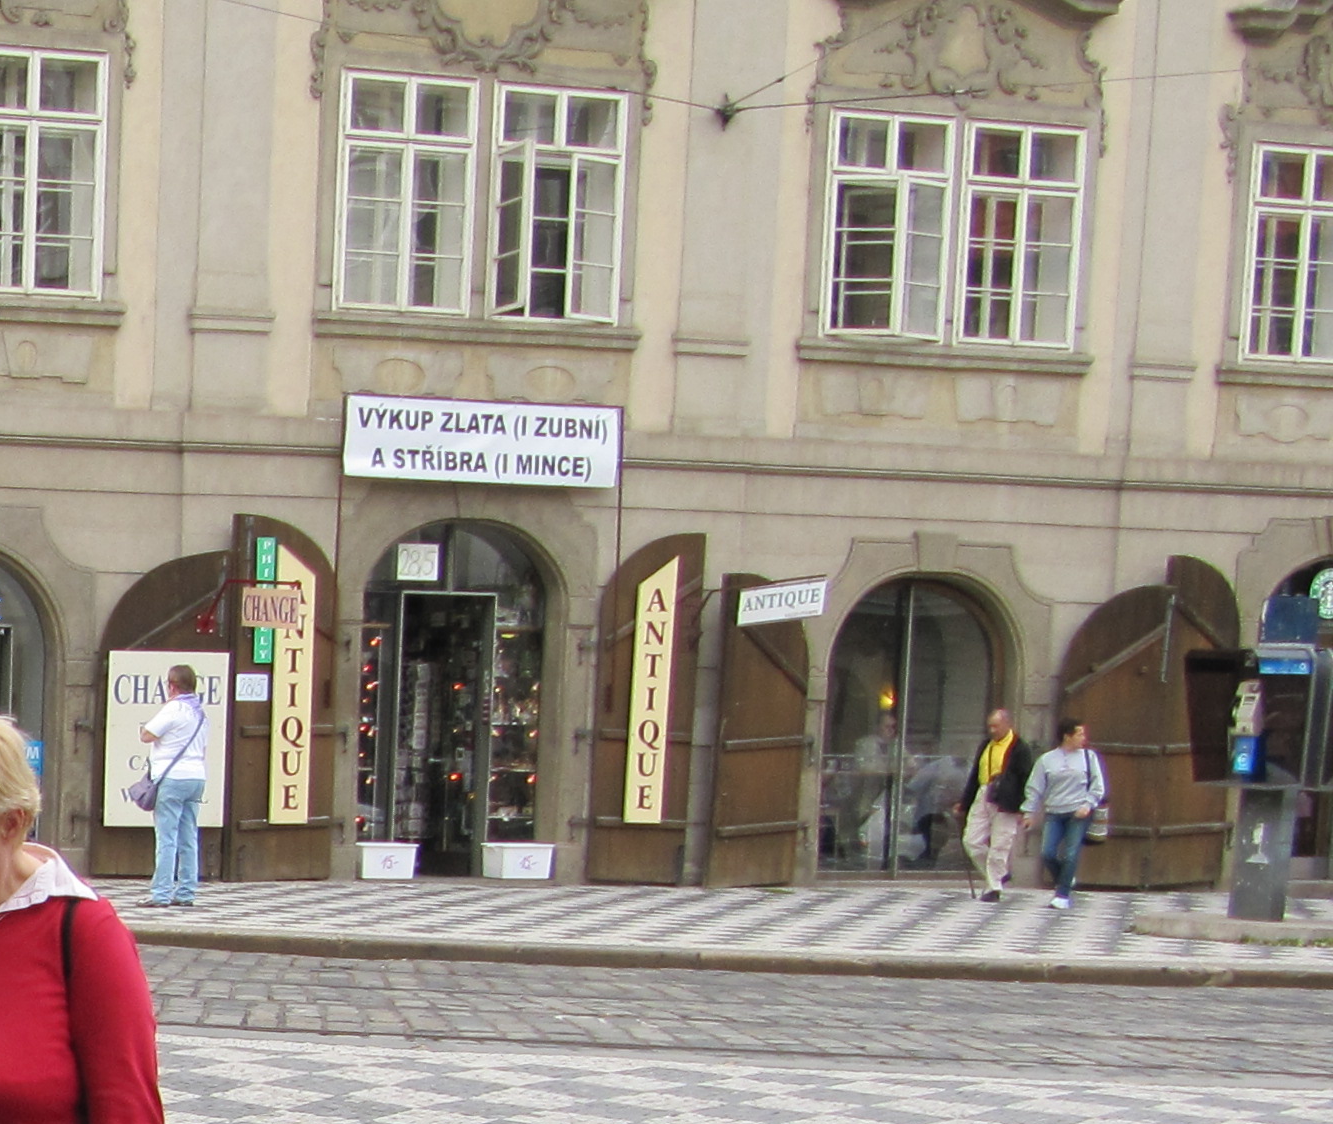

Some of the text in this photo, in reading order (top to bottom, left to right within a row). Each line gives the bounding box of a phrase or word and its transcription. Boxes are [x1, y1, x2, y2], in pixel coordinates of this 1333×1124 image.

[358, 402, 608, 445] VÝKUP ZLATA (I ZUBNÍ)
[371, 445, 592, 483] A STŘÍBRA (I MINCE)
[243, 595, 298, 624] CHANGE
[742, 588, 821, 612] ANTIQUE
[636, 588, 668, 810] ANTIQUE
